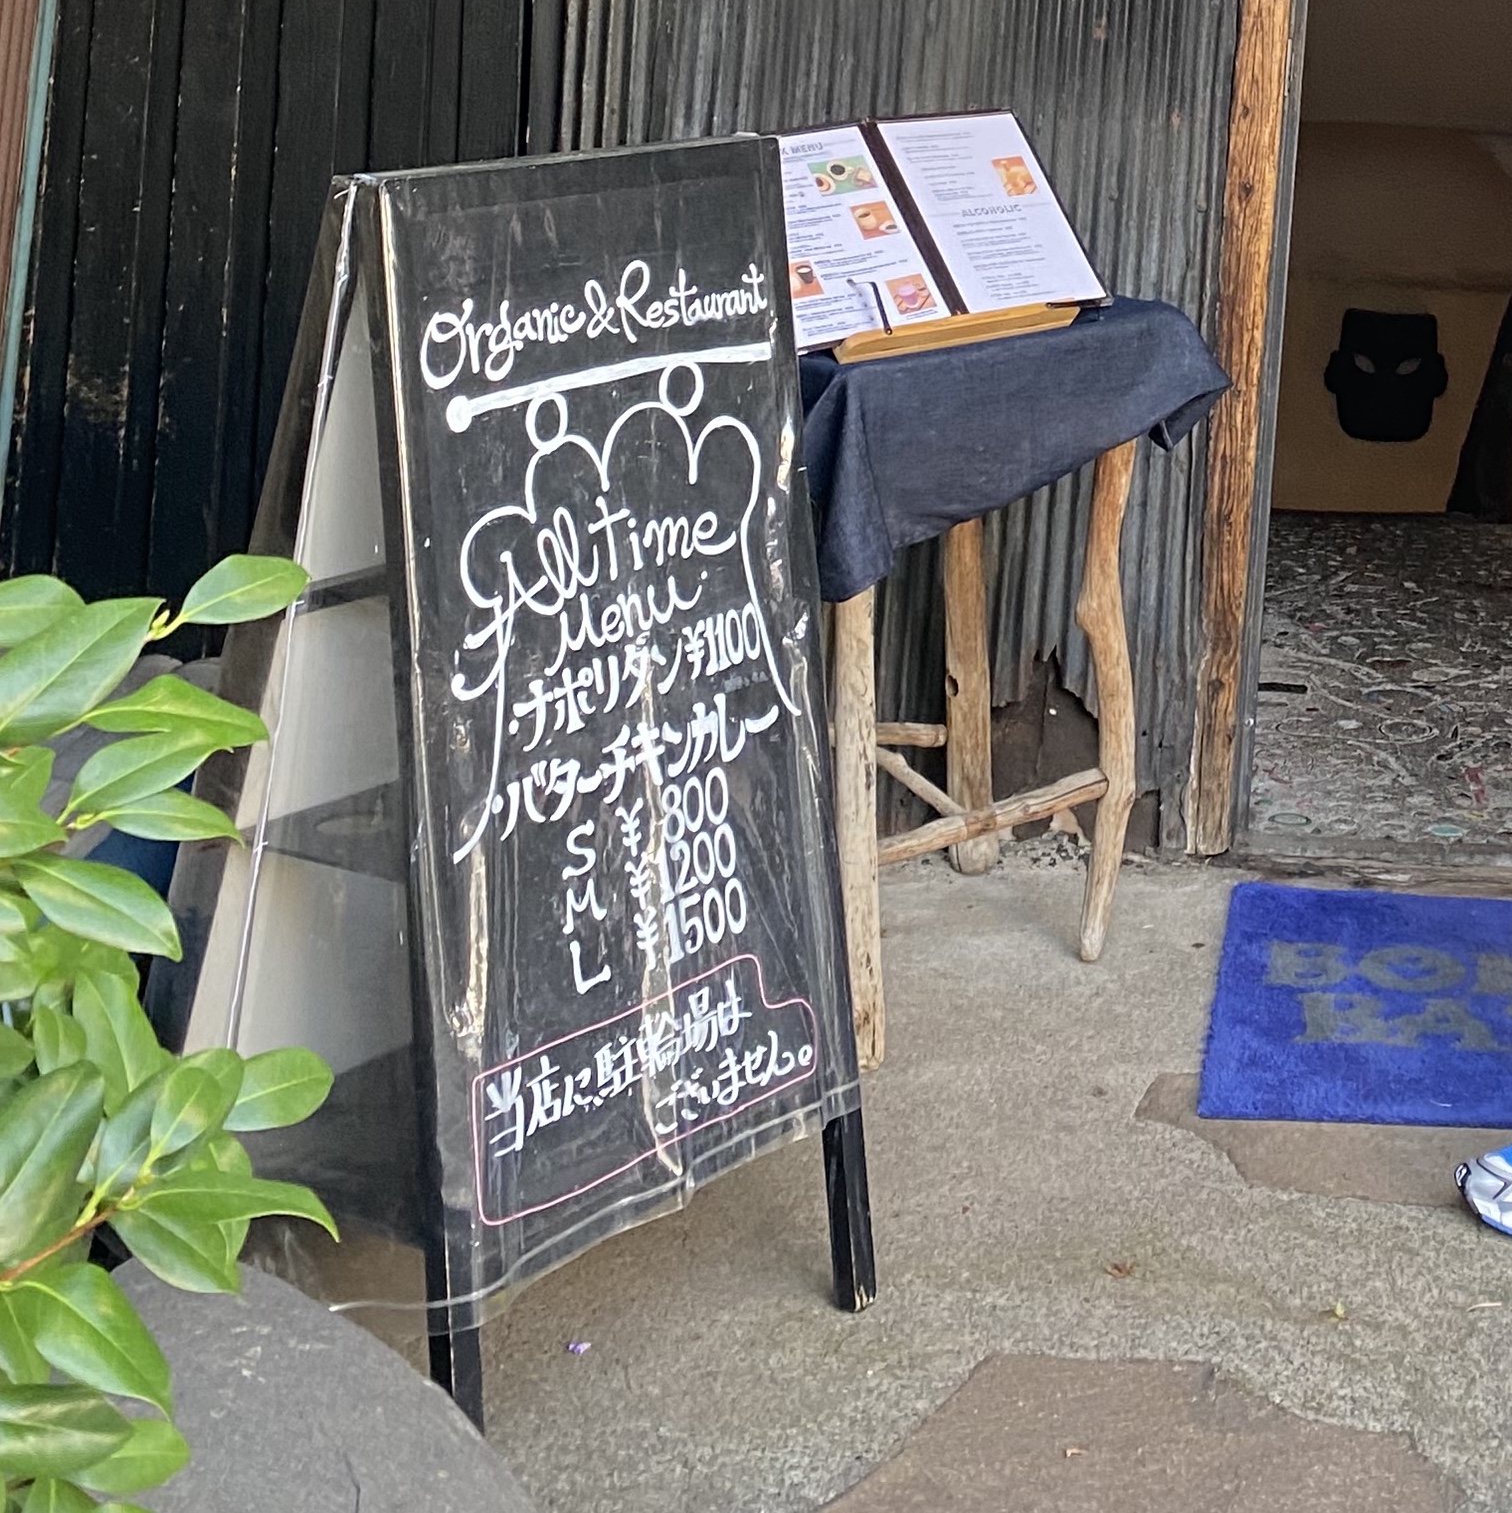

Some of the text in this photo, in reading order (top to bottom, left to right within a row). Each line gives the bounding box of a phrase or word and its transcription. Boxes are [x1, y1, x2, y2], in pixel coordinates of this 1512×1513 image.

[790, 141, 824, 154] MENU
[563, 819, 597, 880] S
[563, 878, 607, 935] M
[569, 940, 612, 995] L
